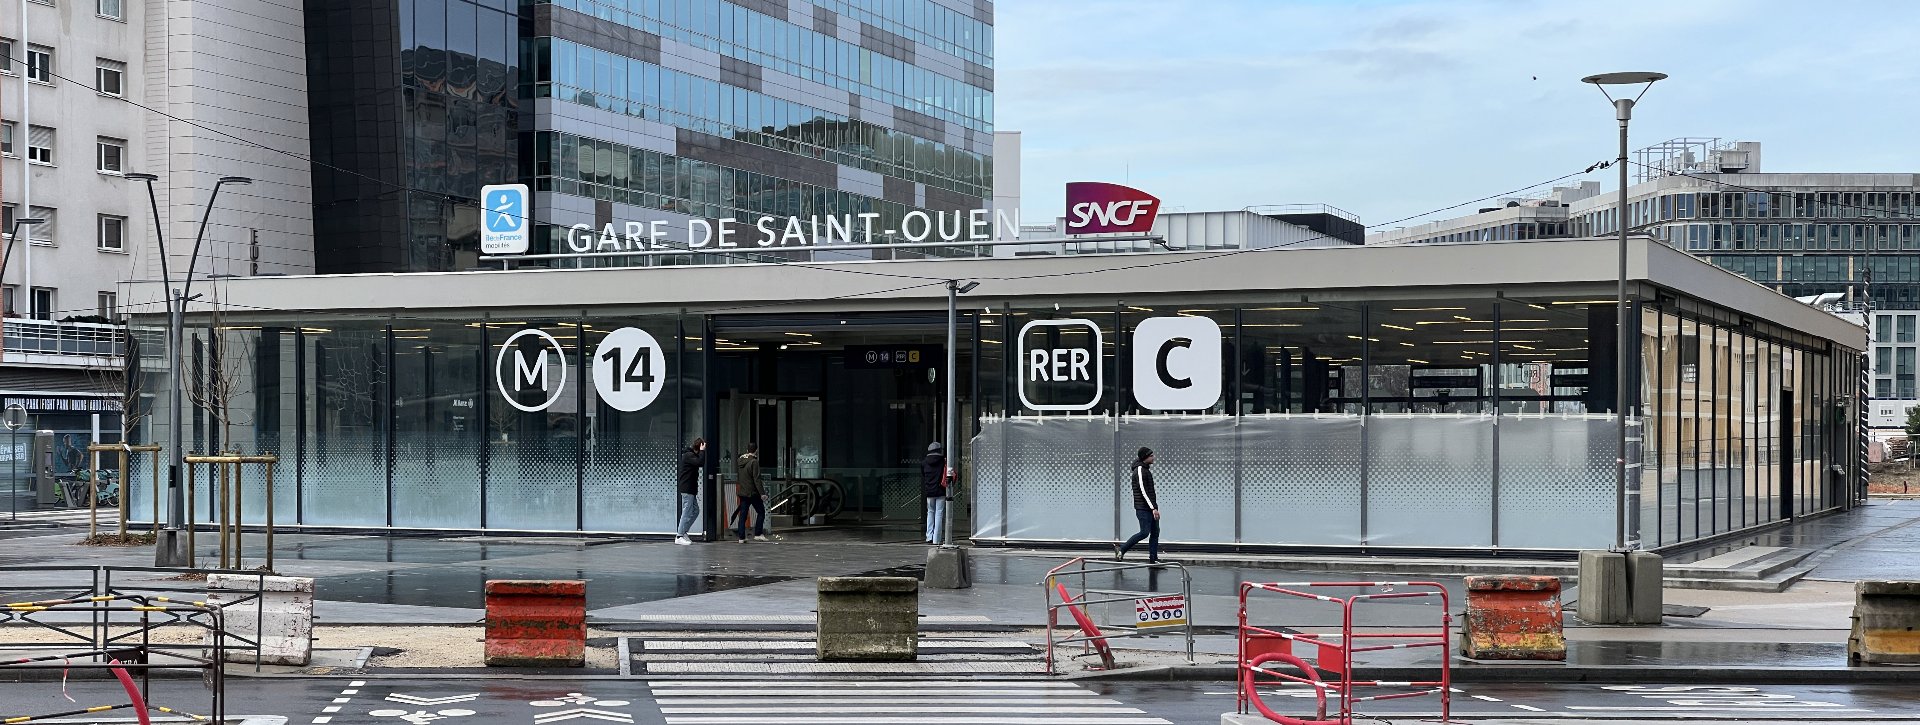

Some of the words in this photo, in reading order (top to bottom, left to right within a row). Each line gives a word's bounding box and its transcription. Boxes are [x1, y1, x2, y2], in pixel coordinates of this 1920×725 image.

[567, 220, 669, 252] GARE
[688, 217, 738, 248] DE
[756, 207, 1020, 247] SAINT-OUEN
[1068, 198, 1153, 228] SNCF
[514, 349, 548, 392] M
[601, 346, 655, 392] 14
[1030, 348, 1090, 382] RER
[1155, 336, 1193, 389] C
[26, 399, 39, 410] PARK
[41, 399, 55, 410] FIGHT
[56, 399, 69, 411] PARK
